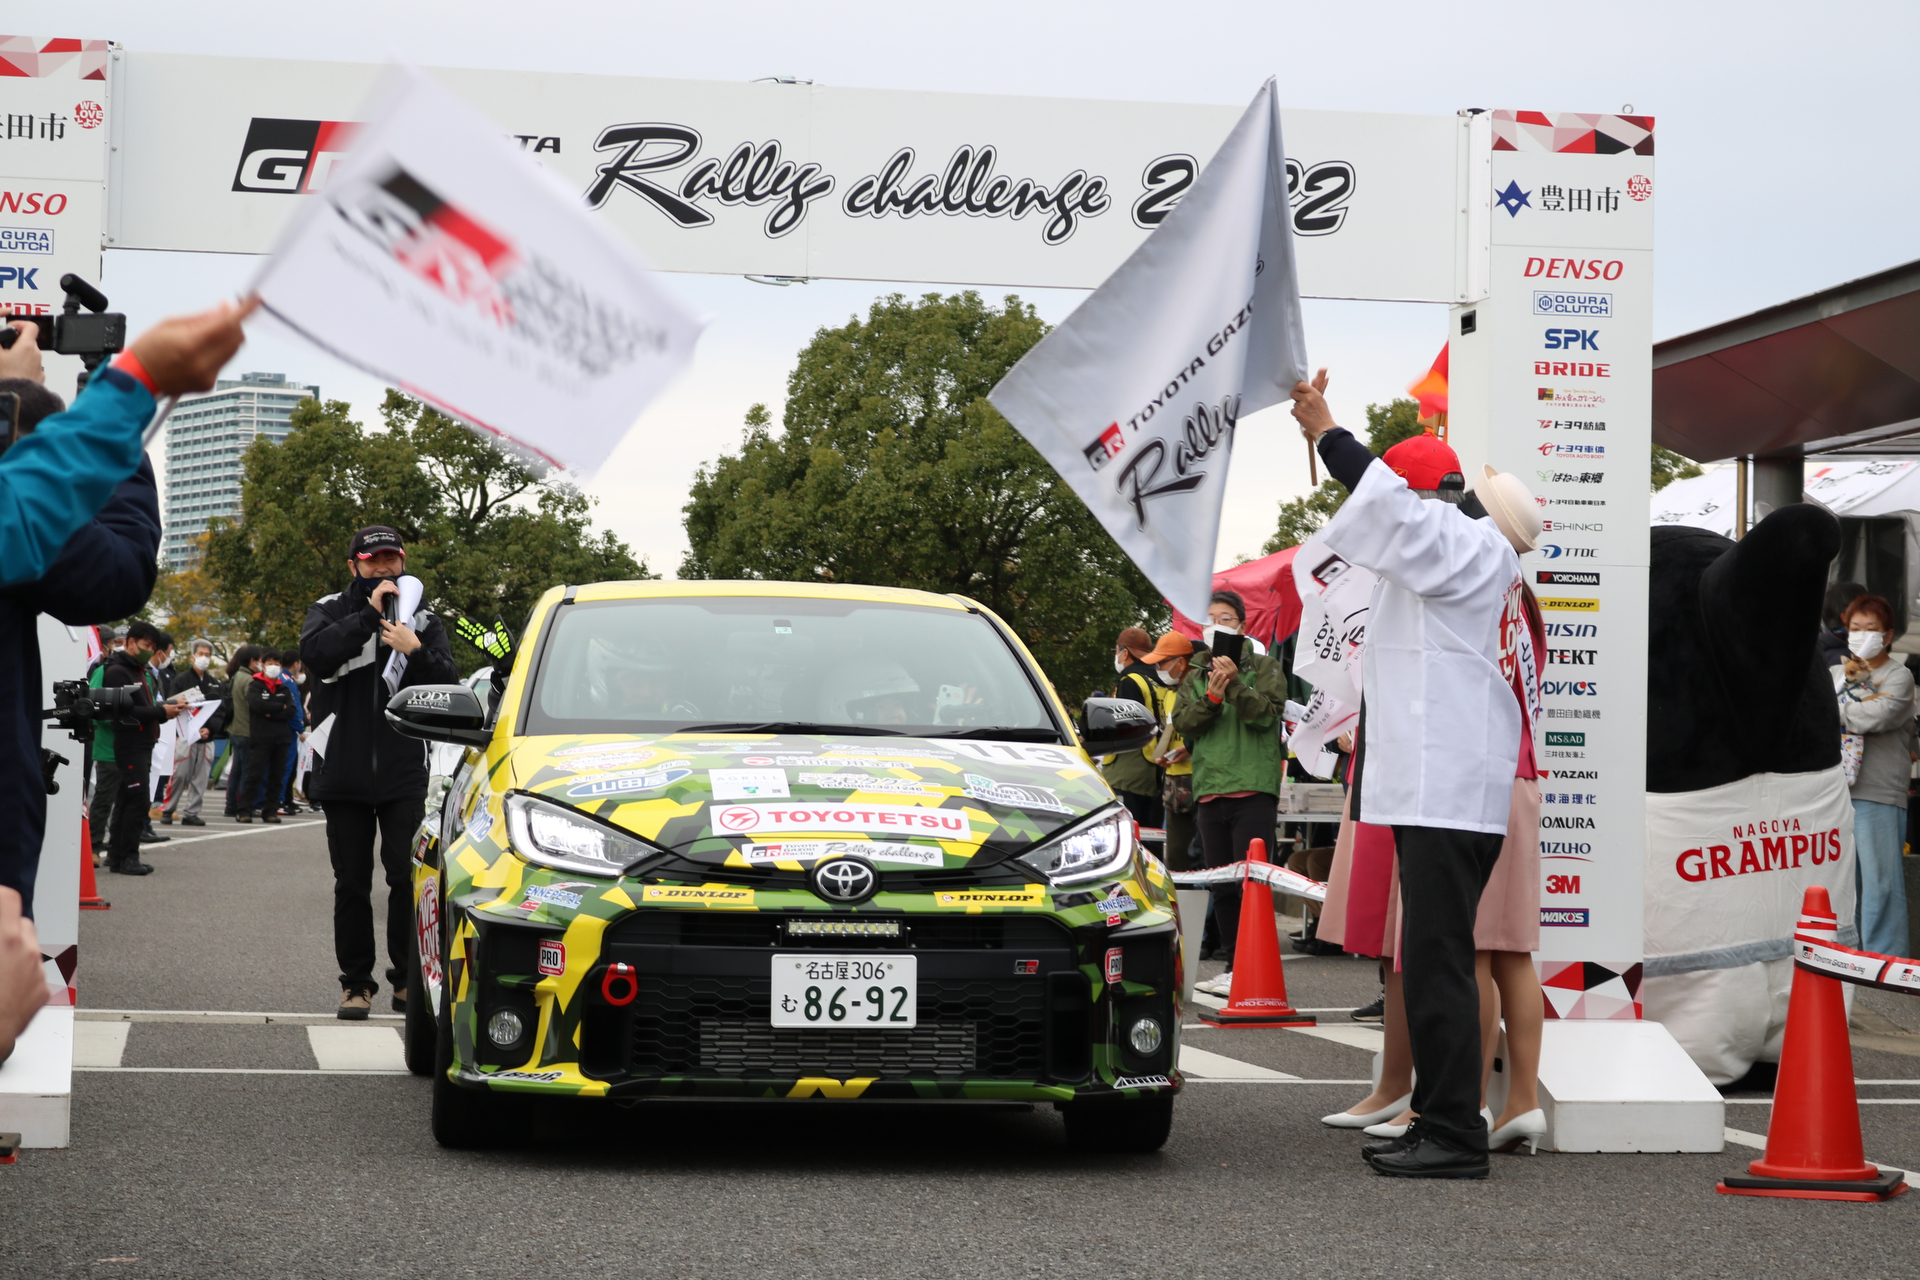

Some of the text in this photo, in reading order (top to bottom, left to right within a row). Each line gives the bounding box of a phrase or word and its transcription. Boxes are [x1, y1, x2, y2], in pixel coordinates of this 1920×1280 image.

[584, 121, 1356, 246] Rally challenge 22
[1631, 175, 1648, 184] WE
[1627, 183, 1653, 192] LOVE
[0, 191, 68, 216] NSO
[1539, 185, 1622, 213] 豊田市
[0, 230, 50, 242] GURA
[0, 240, 50, 251] LUTCH
[1523, 256, 1624, 281] DENSO
[0, 266, 39, 290] PK
[1555, 295, 1609, 305] OGURA
[1555, 304, 1609, 315] CLUTCH
[1544, 328, 1600, 351] SPK
[1533, 361, 1611, 378] BRIDE
[1126, 355, 1207, 433] TOYOTA
[1554, 421, 1606, 431] トヨタ紡織
[1556, 445, 1605, 453] トヨタ車体
[1552, 472, 1604, 484] ばねの東郷
[1553, 522, 1604, 532] SHINKO
[1564, 547, 1599, 558] TTDC
[1552, 573, 1599, 584] YOKOHAMA
[1546, 648, 1598, 665] TEKT
[411, 691, 450, 703] YODA
[1548, 734, 1583, 744] MS&AD
[959, 743, 1073, 765] 113
[716, 774, 781, 783] AGRILL
[1552, 770, 1598, 780] YAZAKI
[969, 775, 993, 789] 57
[1545, 793, 1597, 805] 東海理化
[767, 810, 963, 831] TOYOTETSU
[1732, 818, 1801, 839] NAGOYA
[1675, 827, 1842, 882] GRAMPUS
[1546, 874, 1581, 894] 3M
[525, 885, 583, 906] ENNEPETAL
[665, 889, 748, 900] DUNLOP
[956, 893, 1034, 904] DUNLOP
[542, 949, 558, 966] PRO
[781, 986, 908, 1022] む 86-92
